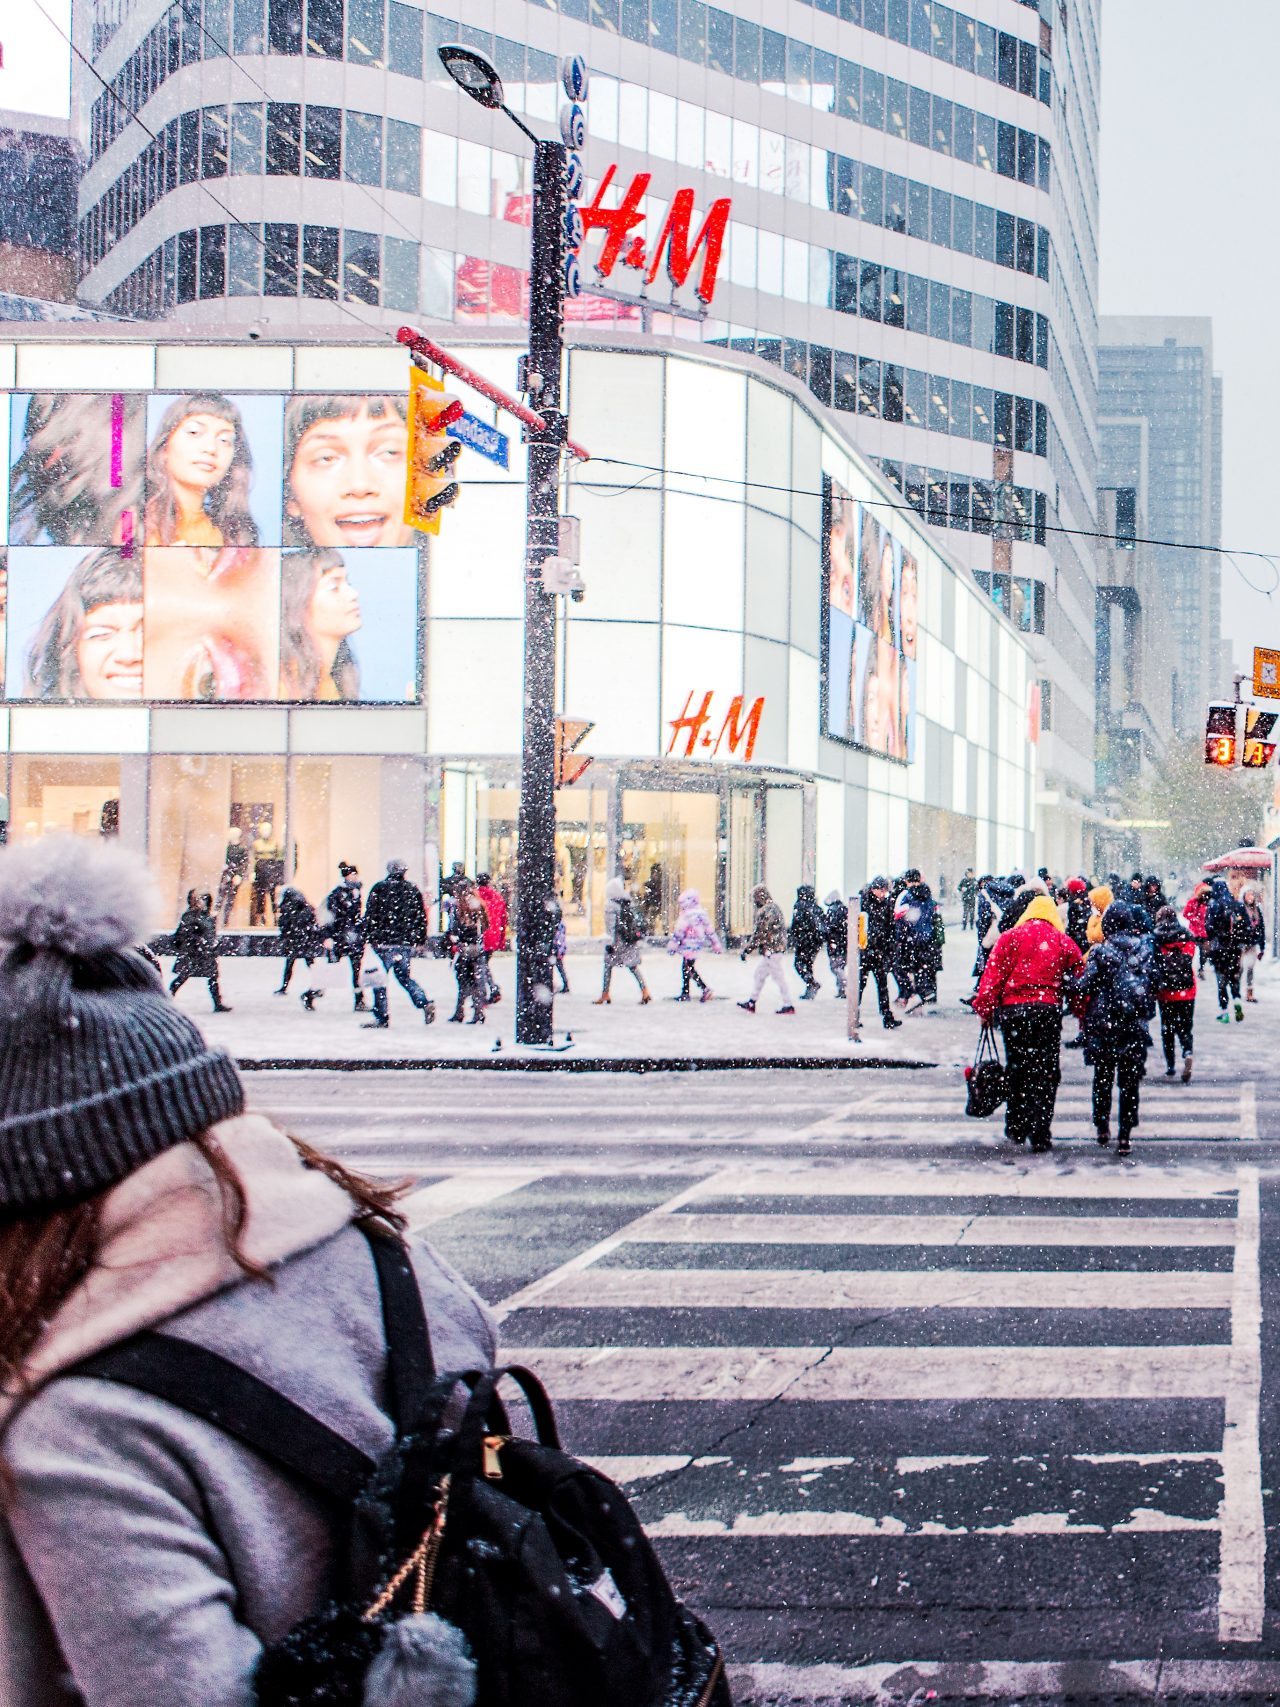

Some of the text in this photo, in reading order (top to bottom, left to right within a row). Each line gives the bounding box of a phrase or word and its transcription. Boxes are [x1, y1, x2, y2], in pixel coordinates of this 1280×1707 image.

[572, 164, 732, 304] H&M
[666, 689, 765, 762] H&M
[1218, 739, 1230, 761] 3
